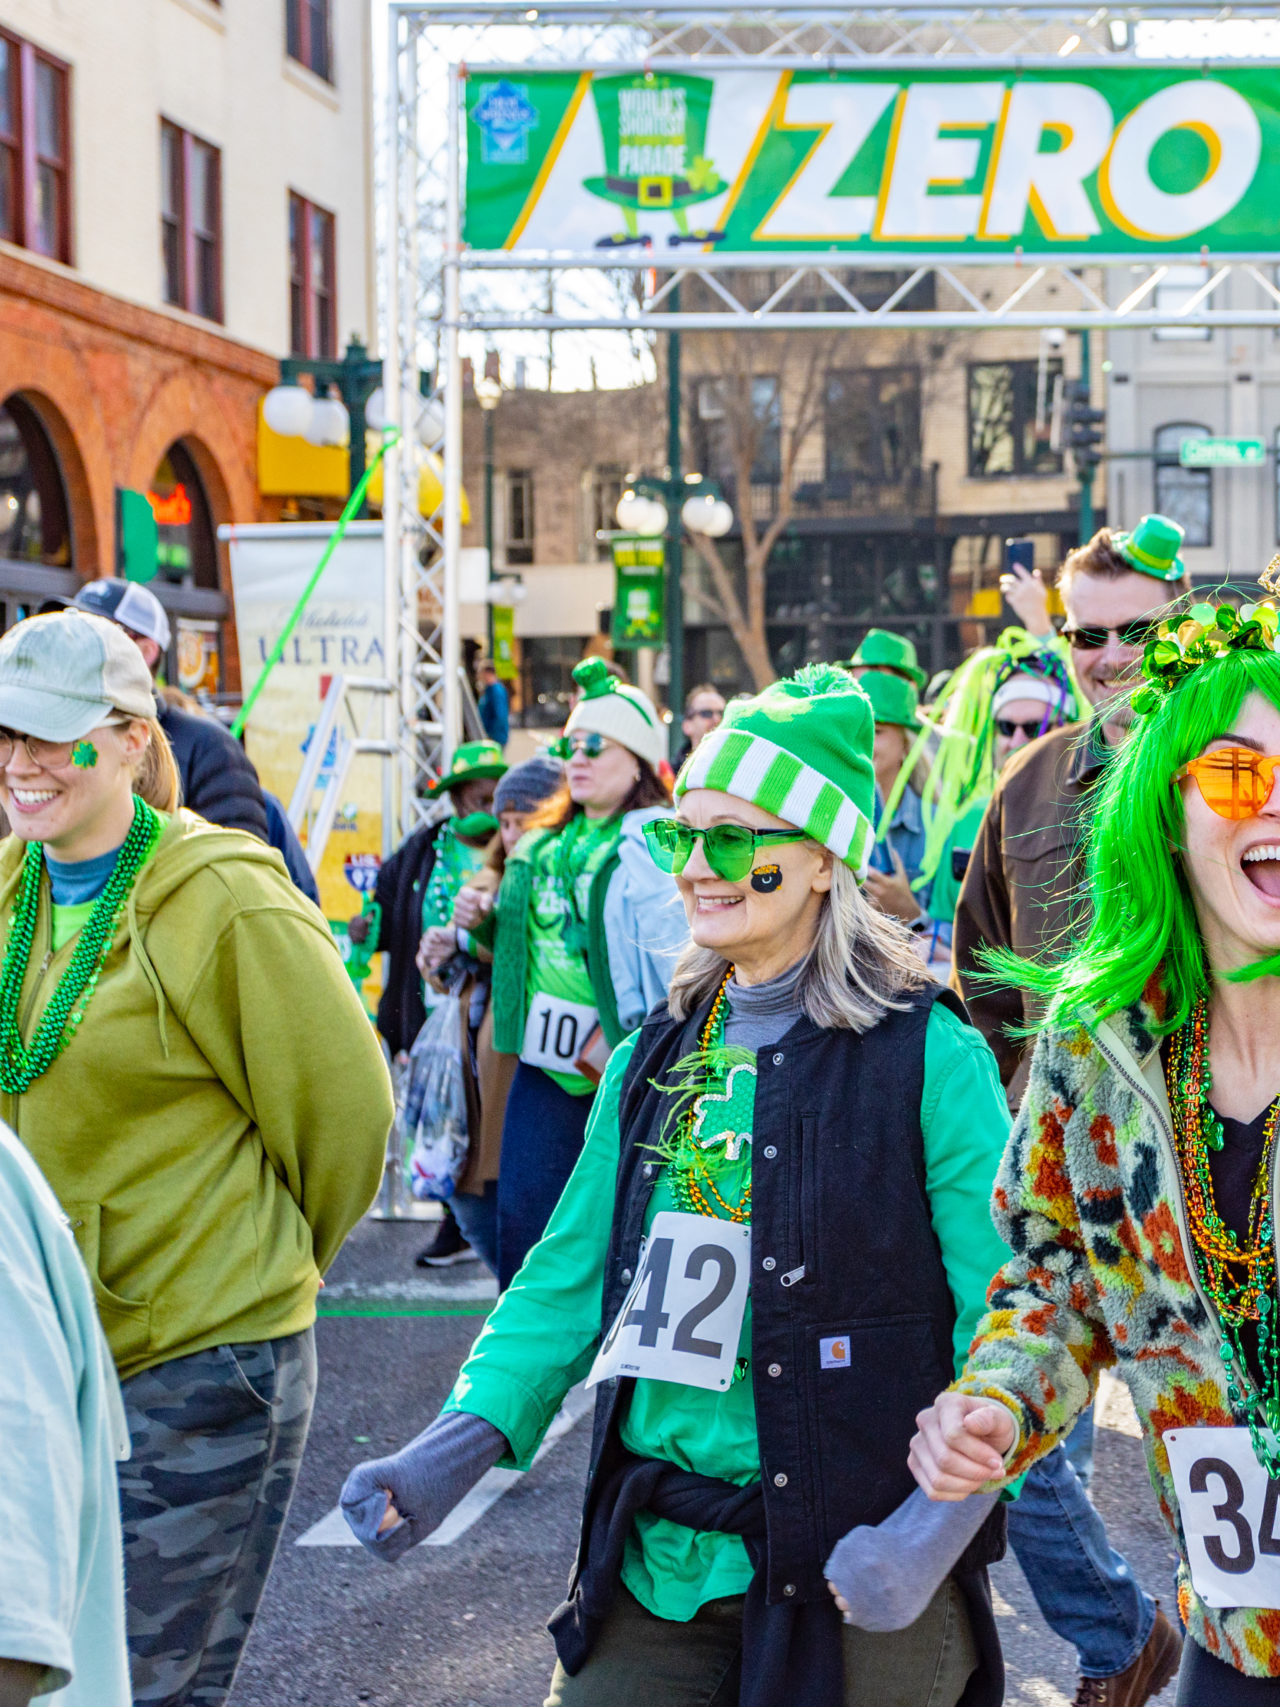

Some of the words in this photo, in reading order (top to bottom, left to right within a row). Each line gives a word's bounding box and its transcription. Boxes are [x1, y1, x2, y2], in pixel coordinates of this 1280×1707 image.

[752, 79, 1263, 242] ZERO
[538, 1008, 578, 1060] 10
[602, 1236, 737, 1360] 42
